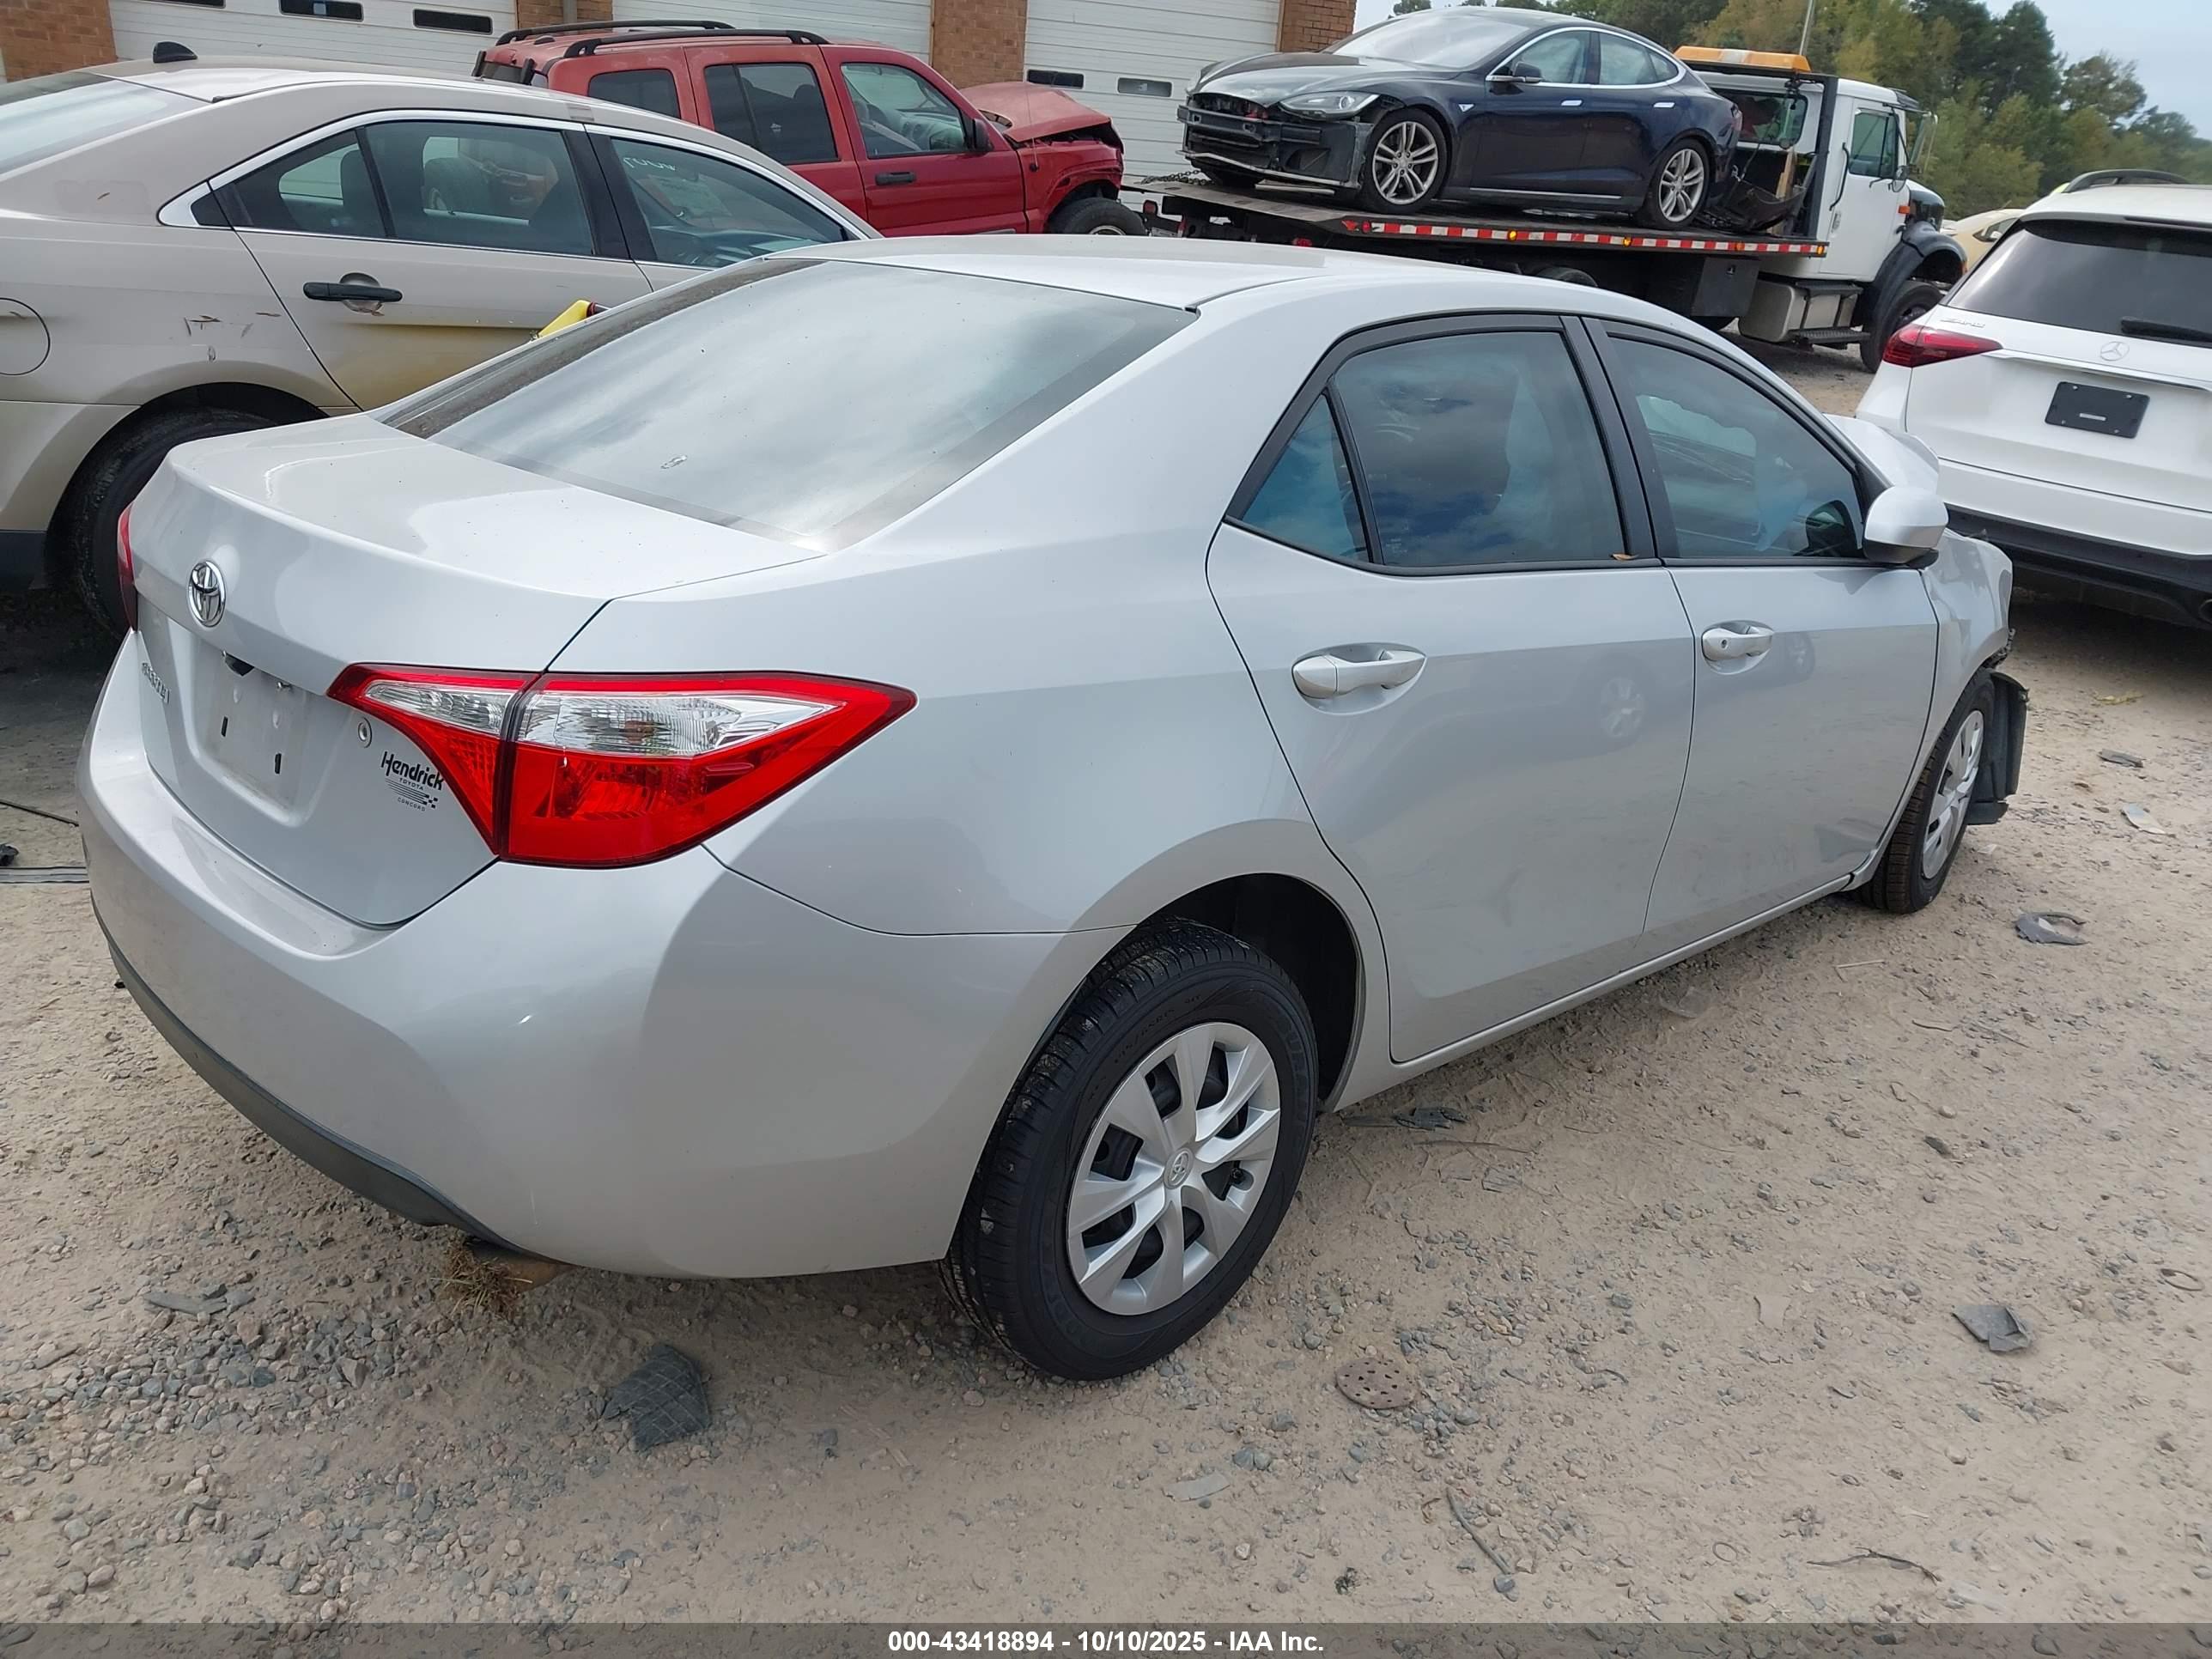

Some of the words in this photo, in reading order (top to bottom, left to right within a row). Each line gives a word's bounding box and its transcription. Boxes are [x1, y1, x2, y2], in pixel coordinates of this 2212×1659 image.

[380, 750, 444, 791] Hendrick
[398, 777, 424, 791] TOYOTA
[398, 797, 426, 811] CONCORD
